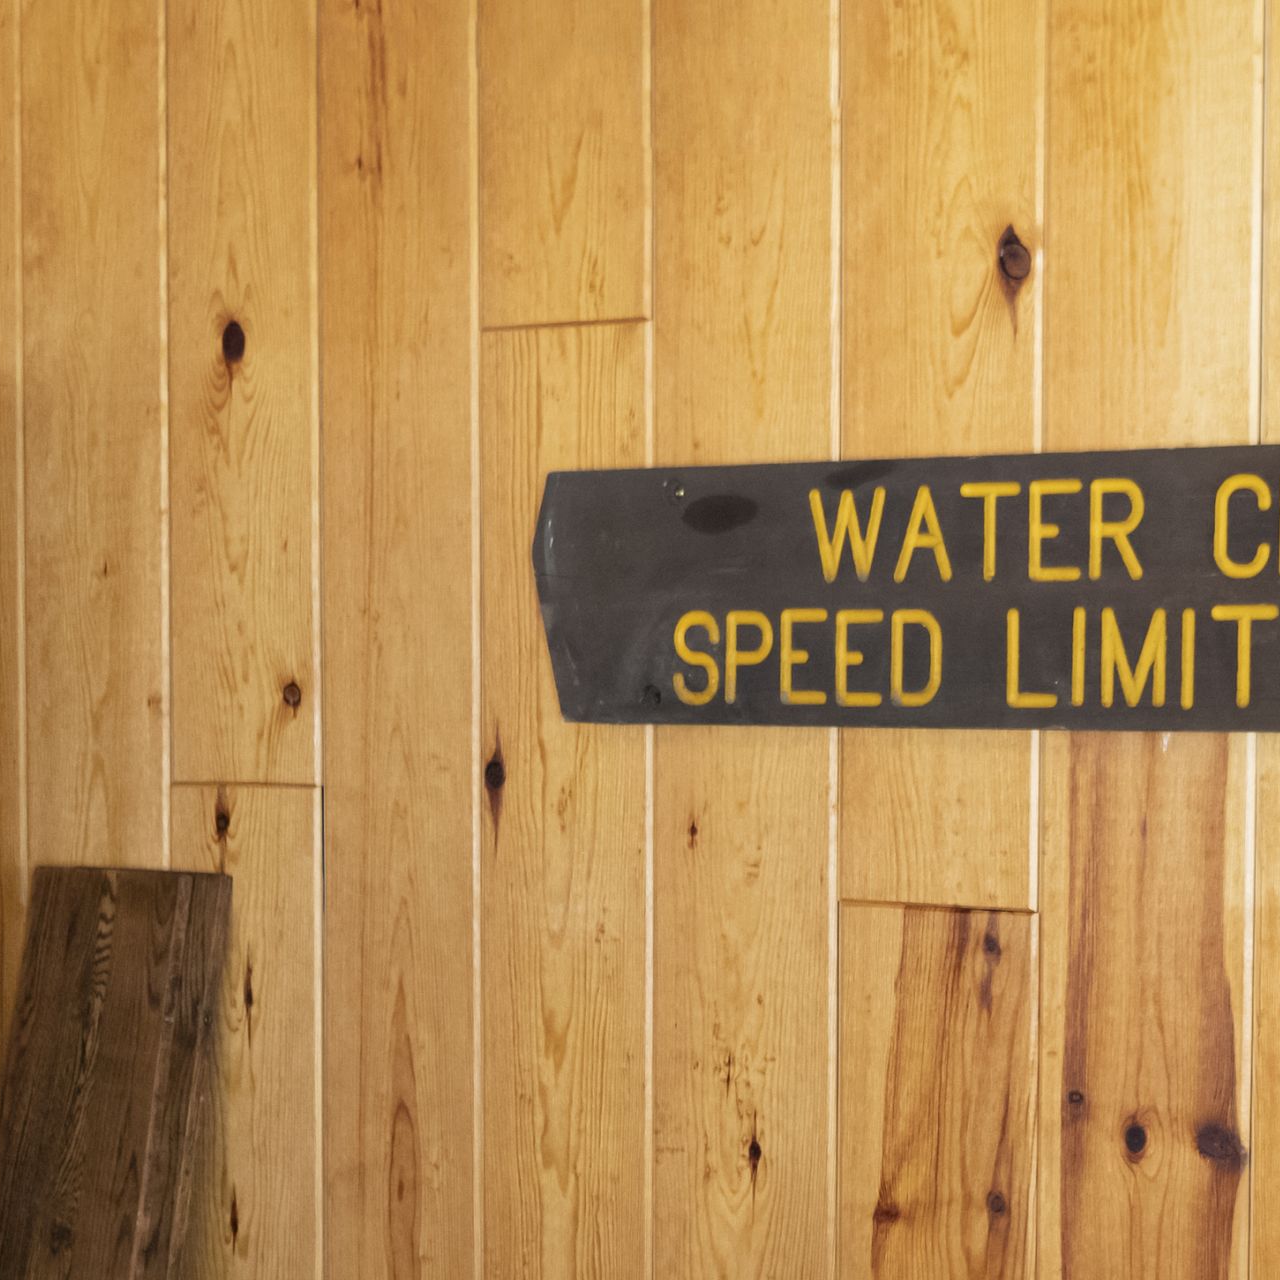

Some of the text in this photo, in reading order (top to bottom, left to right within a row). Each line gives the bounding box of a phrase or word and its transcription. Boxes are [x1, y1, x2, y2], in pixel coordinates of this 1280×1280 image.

[809, 477, 1146, 582] WATER
[673, 608, 943, 707] SPEED
[1006, 603, 1279, 709] LIMIT
